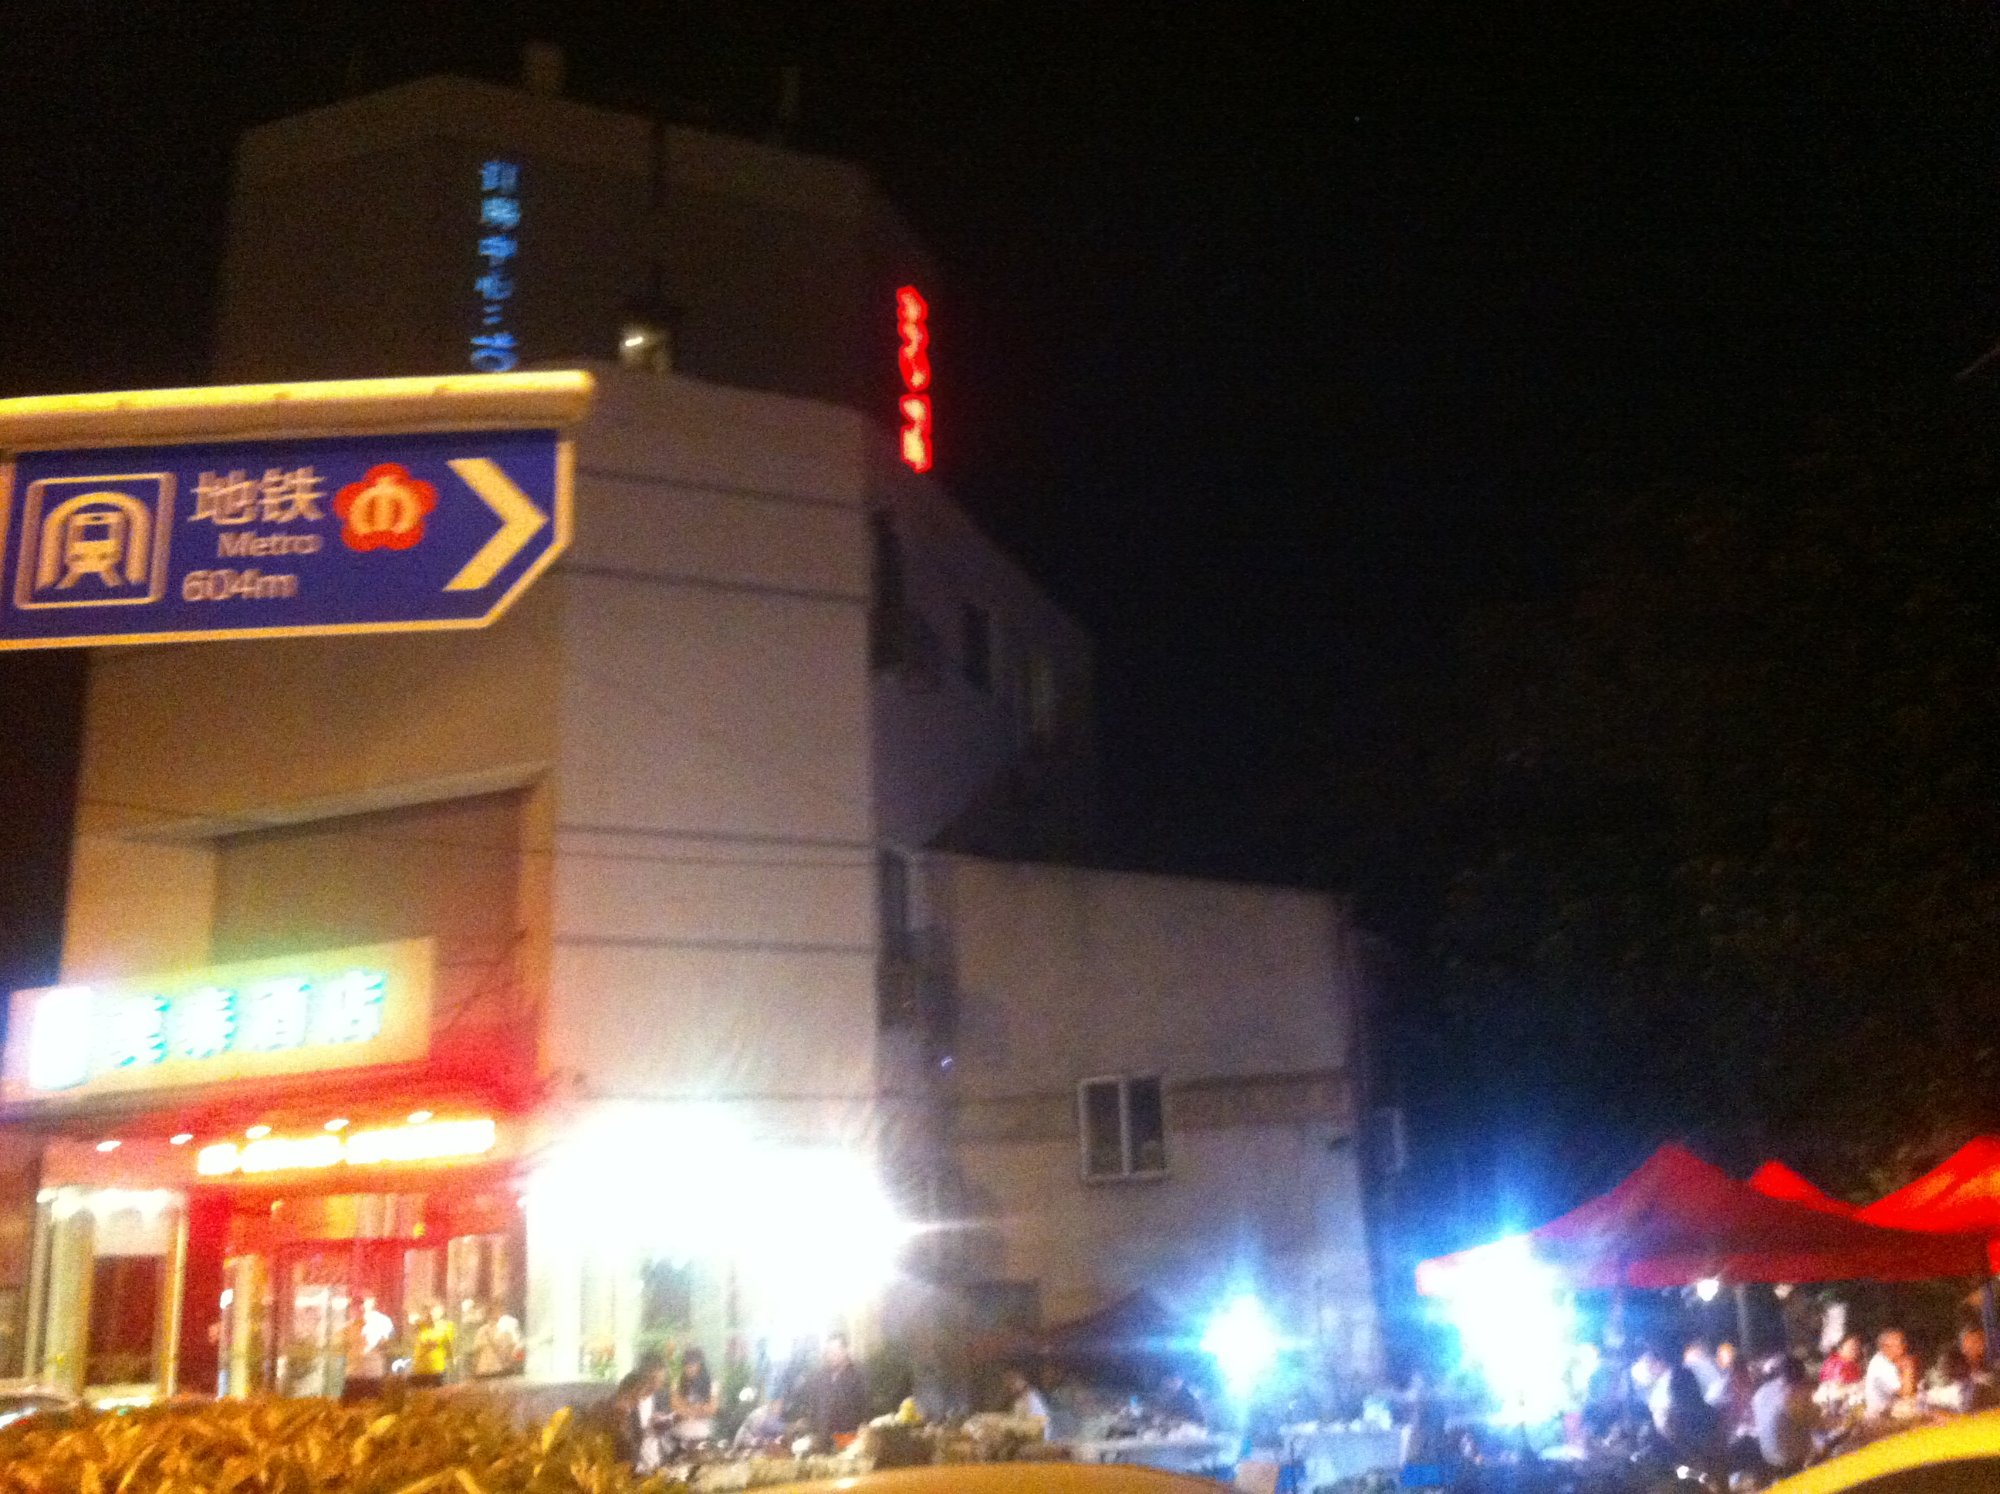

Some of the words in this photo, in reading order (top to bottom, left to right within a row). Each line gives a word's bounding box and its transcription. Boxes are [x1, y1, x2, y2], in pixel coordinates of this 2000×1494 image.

[188, 466, 326, 525] 地铁
[218, 532, 323, 557] Metro
[183, 569, 299, 602] 604m
